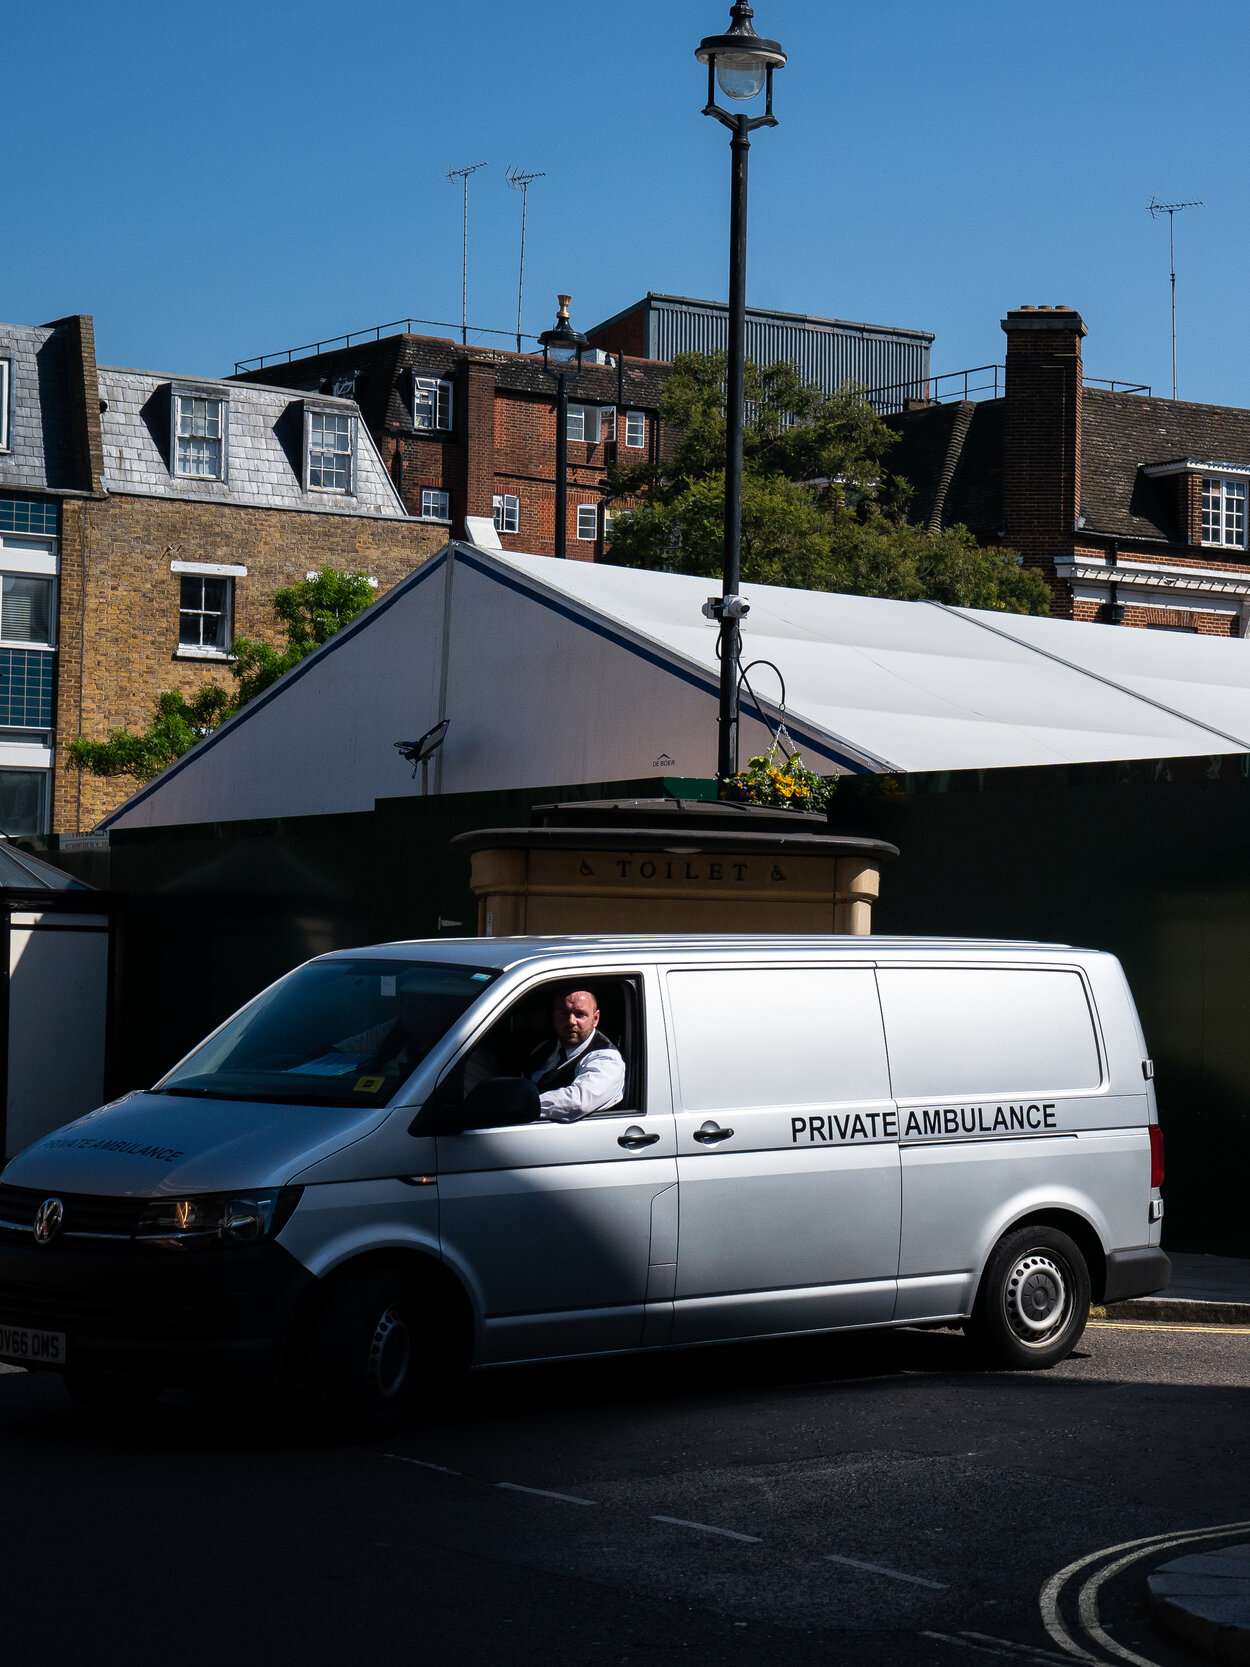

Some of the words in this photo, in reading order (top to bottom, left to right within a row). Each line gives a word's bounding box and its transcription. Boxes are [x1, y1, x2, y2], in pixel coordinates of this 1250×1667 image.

[617, 860, 747, 881] TOILET
[791, 1111, 898, 1143] PRIVATE
[904, 1103, 1057, 1136] AMBULANCE
[88, 1138, 185, 1162] AMBULANCE
